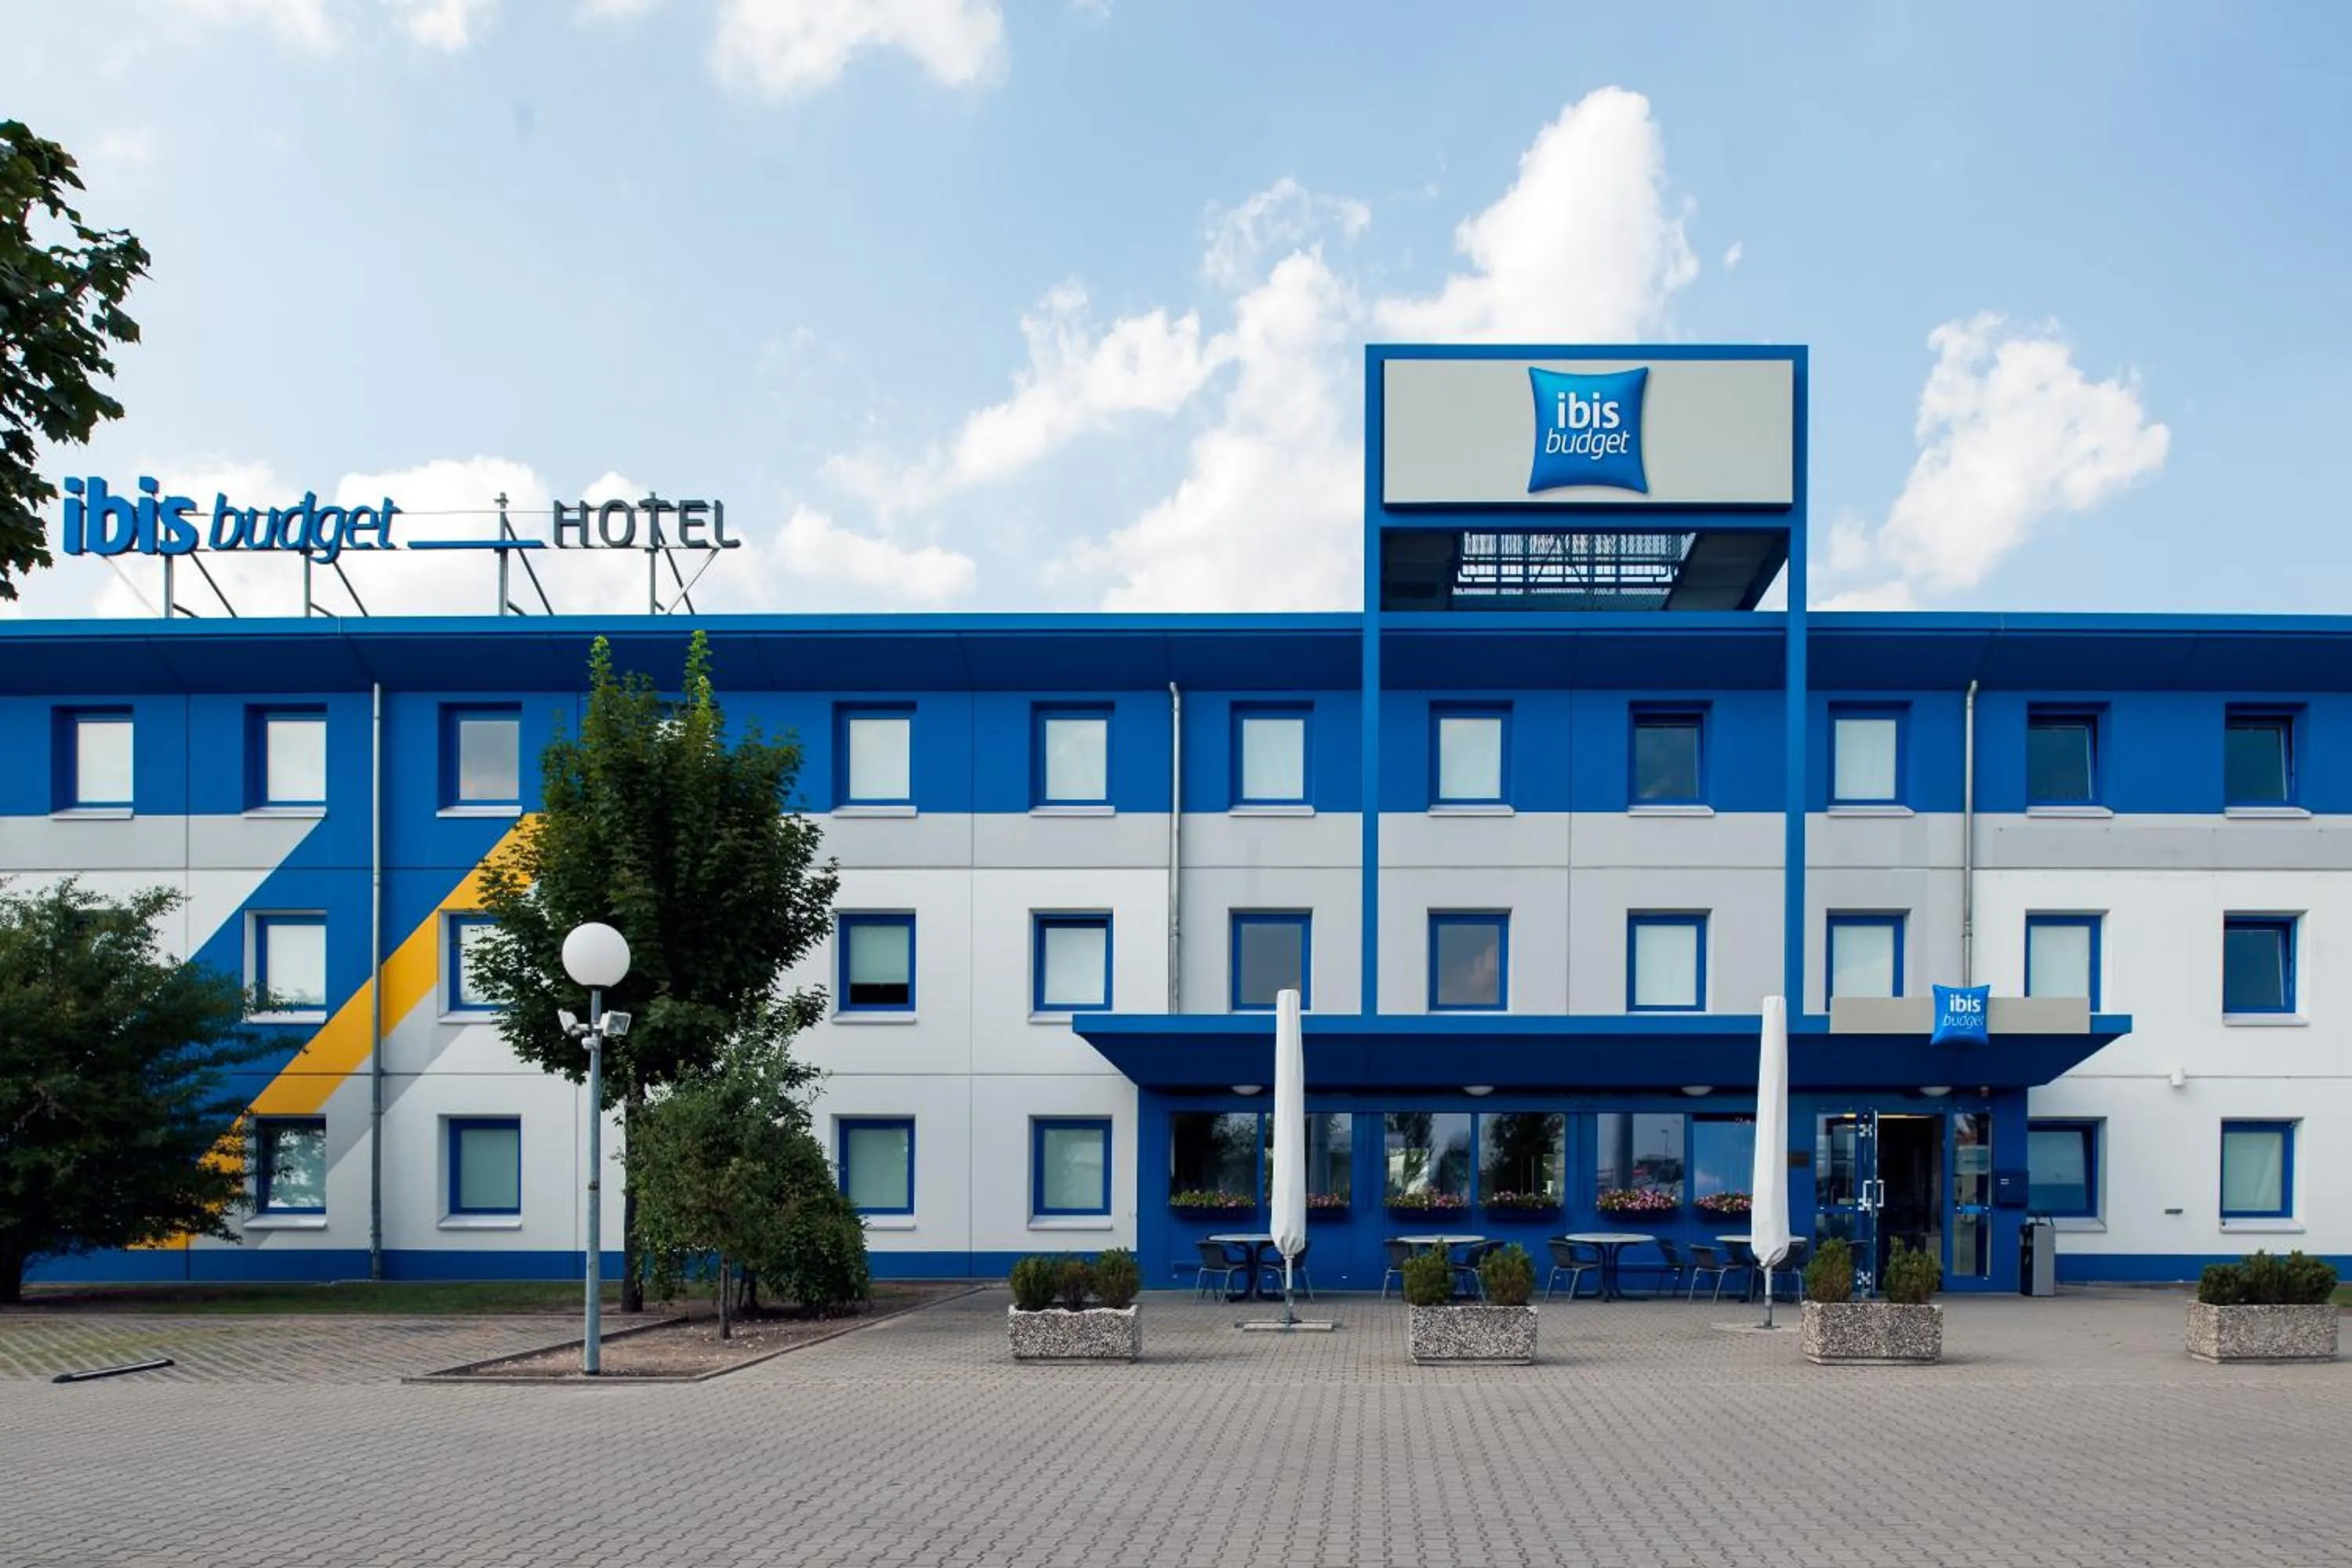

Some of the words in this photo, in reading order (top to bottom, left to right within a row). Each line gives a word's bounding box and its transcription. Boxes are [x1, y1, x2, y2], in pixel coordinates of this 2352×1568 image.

[1558, 392, 1621, 429] ibis
[1545, 428, 1630, 460] budget
[64, 476, 199, 556] ibis
[208, 491, 401, 564] budget
[554, 499, 741, 549] HOTEL
[1950, 993, 1981, 1013] ibis
